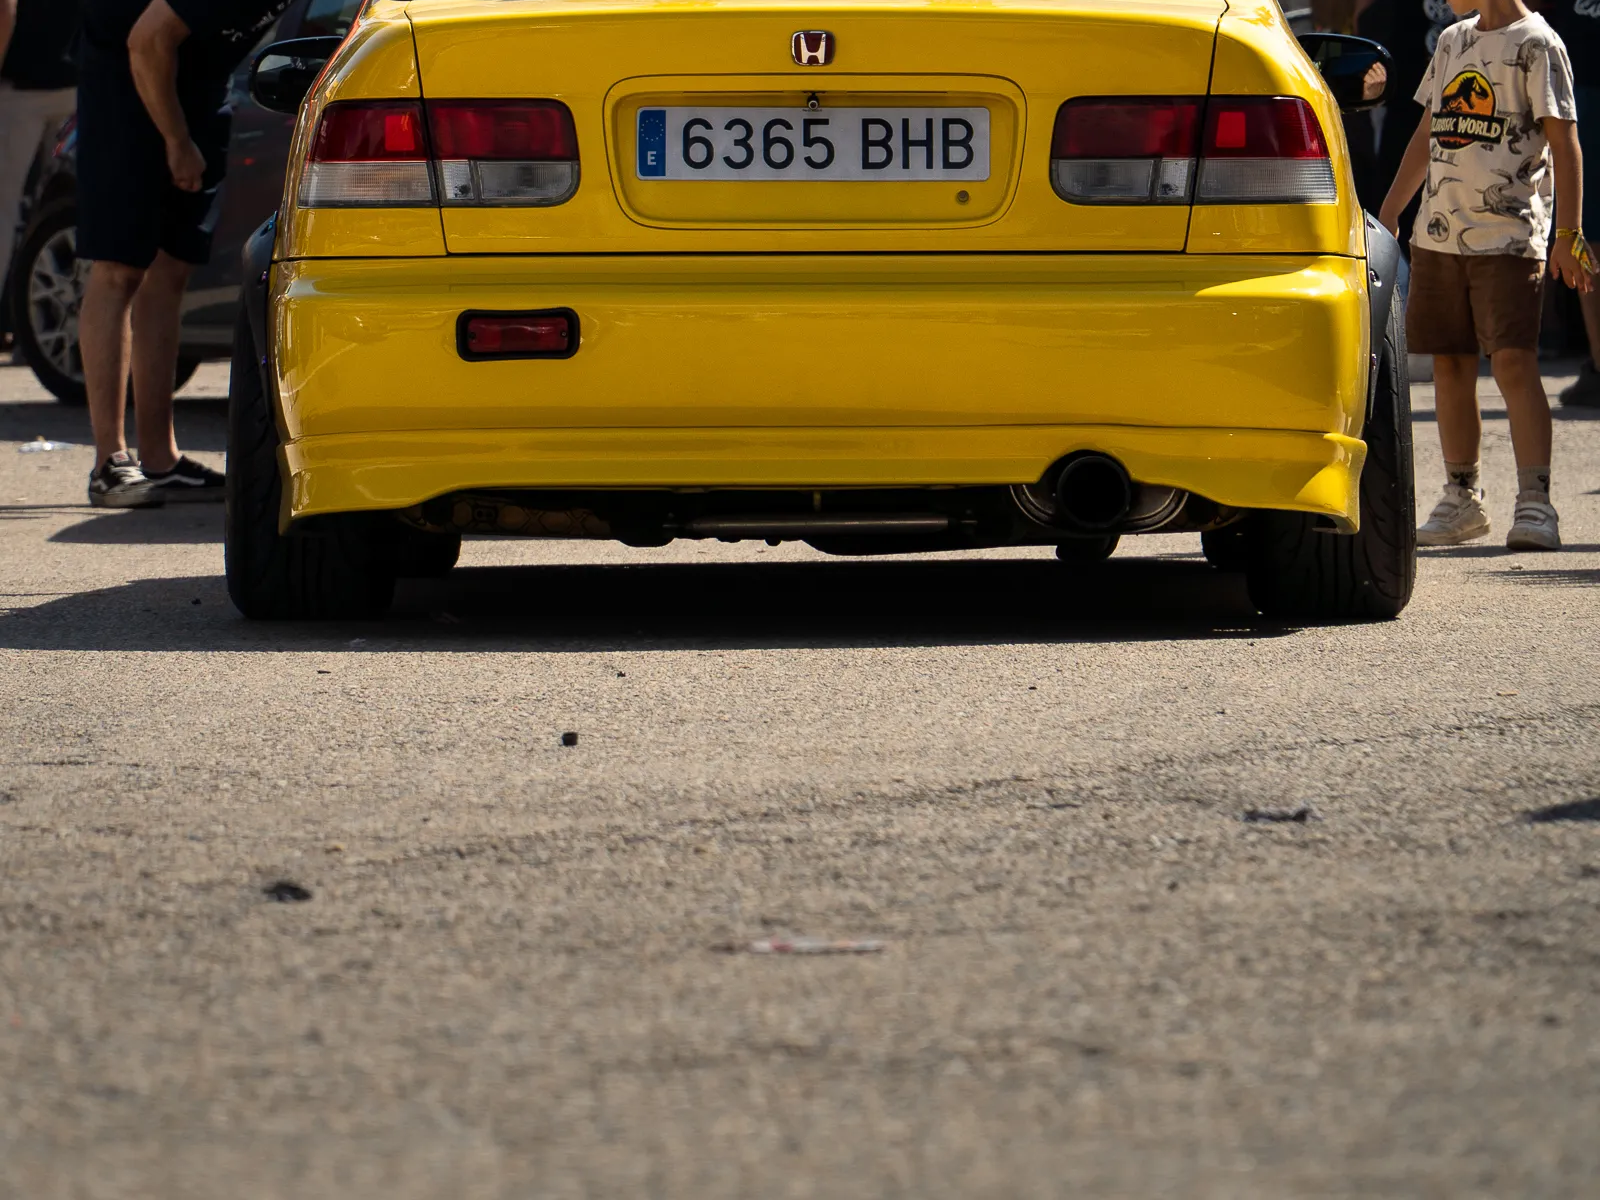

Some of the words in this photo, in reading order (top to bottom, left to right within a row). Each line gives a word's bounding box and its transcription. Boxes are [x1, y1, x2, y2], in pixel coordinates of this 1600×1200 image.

[1457, 116, 1501, 138] WORLD
[682, 117, 835, 170] 6365
[862, 118, 974, 170] BHB
[647, 151, 657, 166] E
